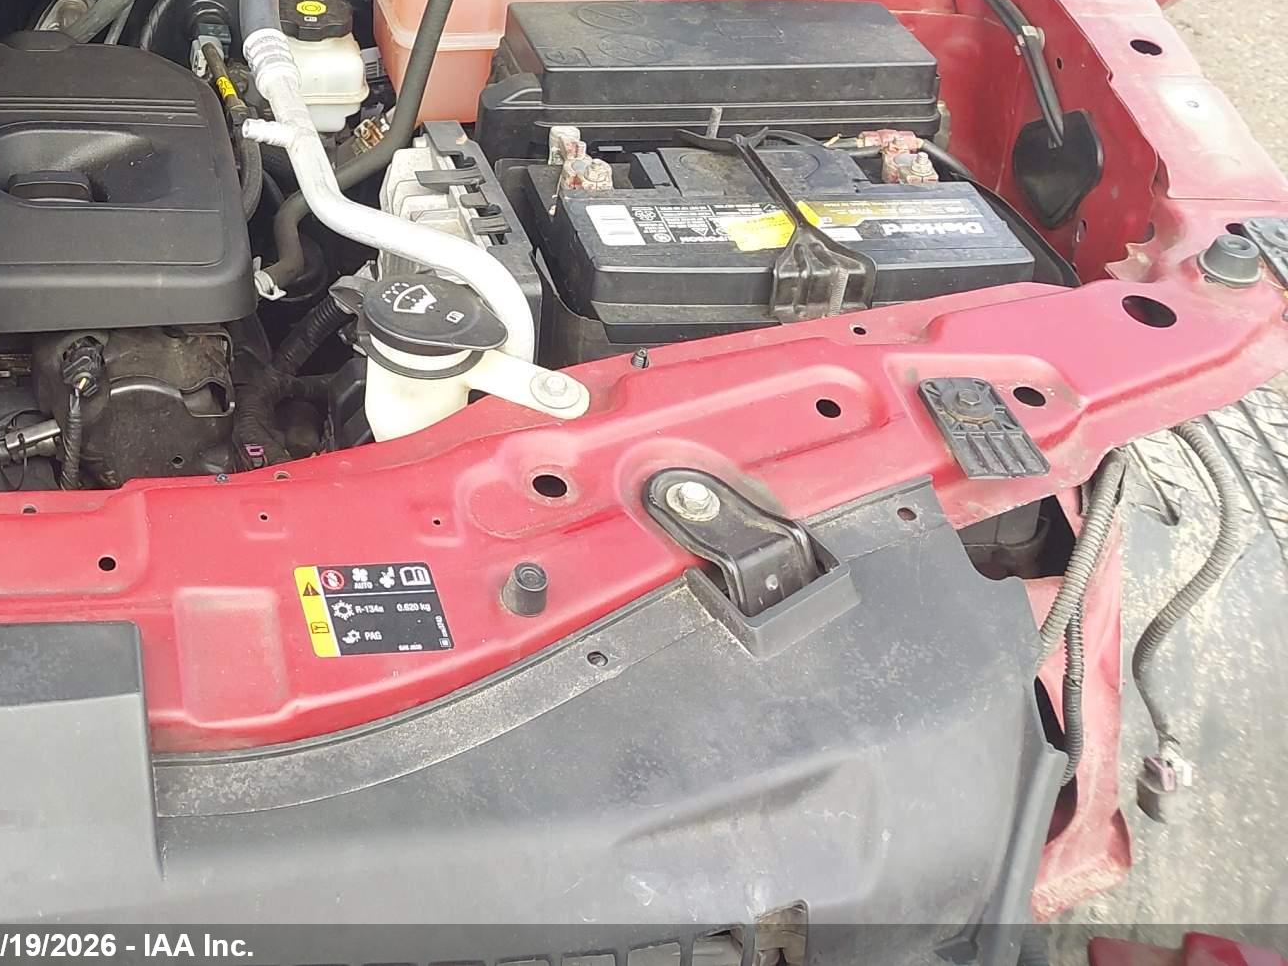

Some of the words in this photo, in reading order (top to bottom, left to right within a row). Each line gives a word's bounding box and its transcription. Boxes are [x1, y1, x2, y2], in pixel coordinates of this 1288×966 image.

[881, 222, 986, 237] DieHard
[354, 581, 373, 589] AUTO
[355, 605, 385, 613] R-134a
[420, 603, 431, 612] kg
[365, 631, 382, 641] PAG
